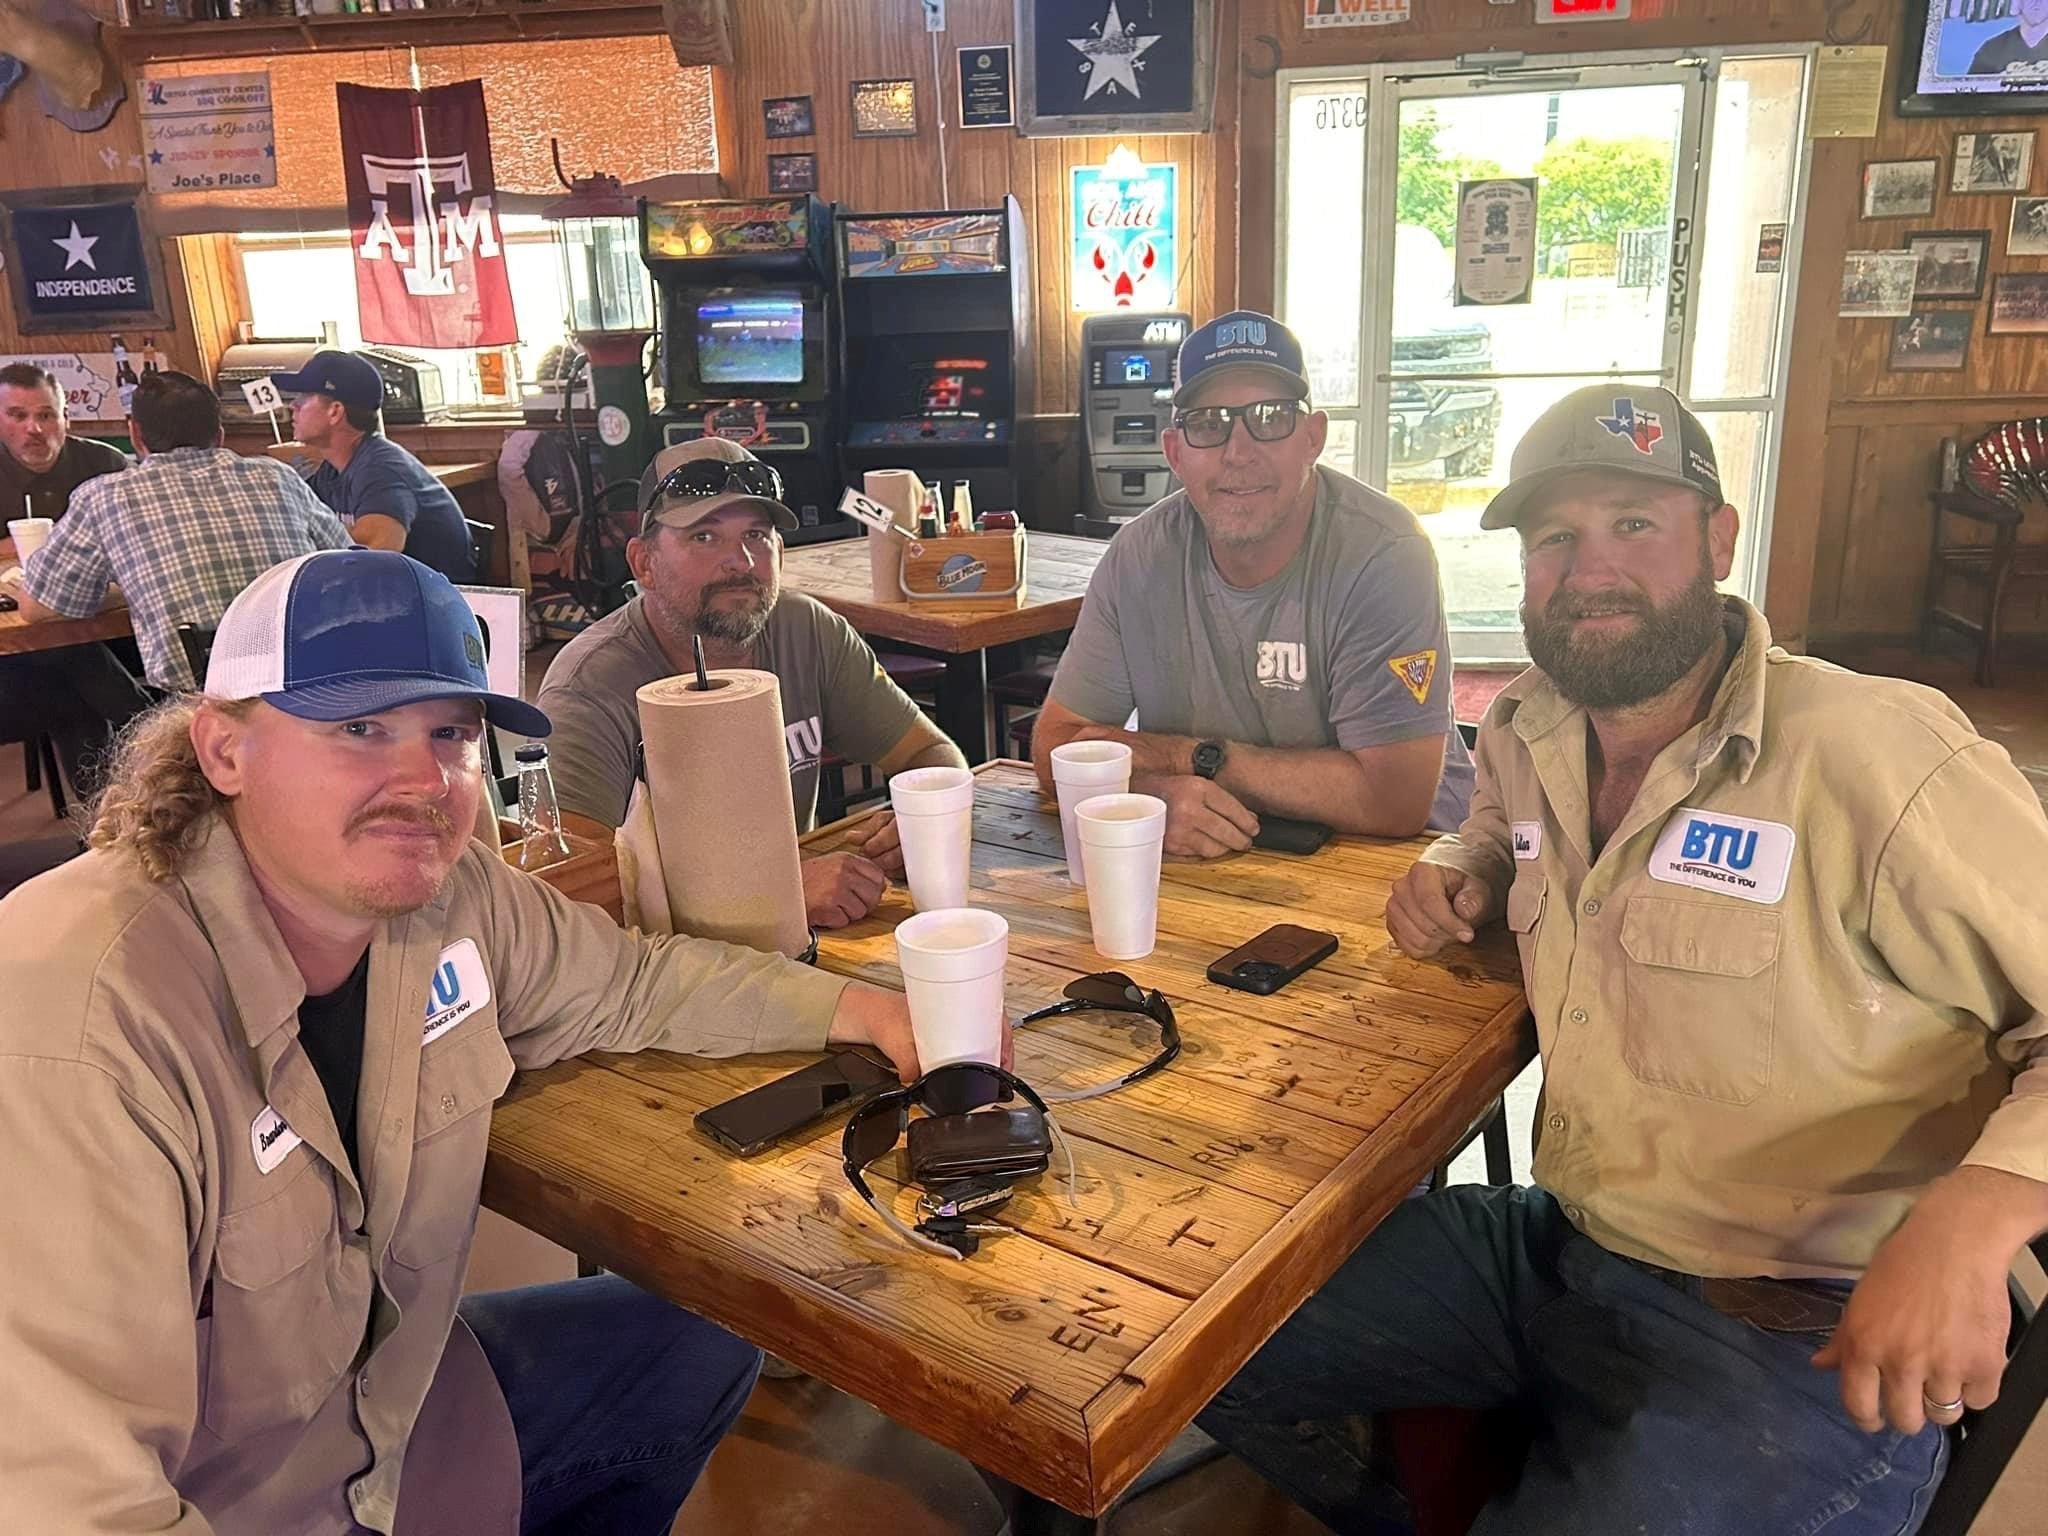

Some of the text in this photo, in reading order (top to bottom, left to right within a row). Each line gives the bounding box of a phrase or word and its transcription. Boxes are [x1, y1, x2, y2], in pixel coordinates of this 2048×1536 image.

[1306, 12, 1408, 25] SERVICES
[172, 173, 262, 187] Joe's Place
[1668, 217, 1691, 317] PUSH
[36, 276, 137, 297] INDEPENDENCE
[1143, 322, 1182, 342] ATM
[1216, 320, 1267, 349] BTU
[252, 385, 274, 405] 13
[853, 497, 883, 522] 12
[938, 562, 986, 587] BLUE MOON
[1257, 641, 1307, 682] BTU
[1681, 819, 1759, 871] BTU
[1669, 861, 1757, 889] THE DIFFERENCE IS YOU
[456, 1000, 471, 1014] YOU
